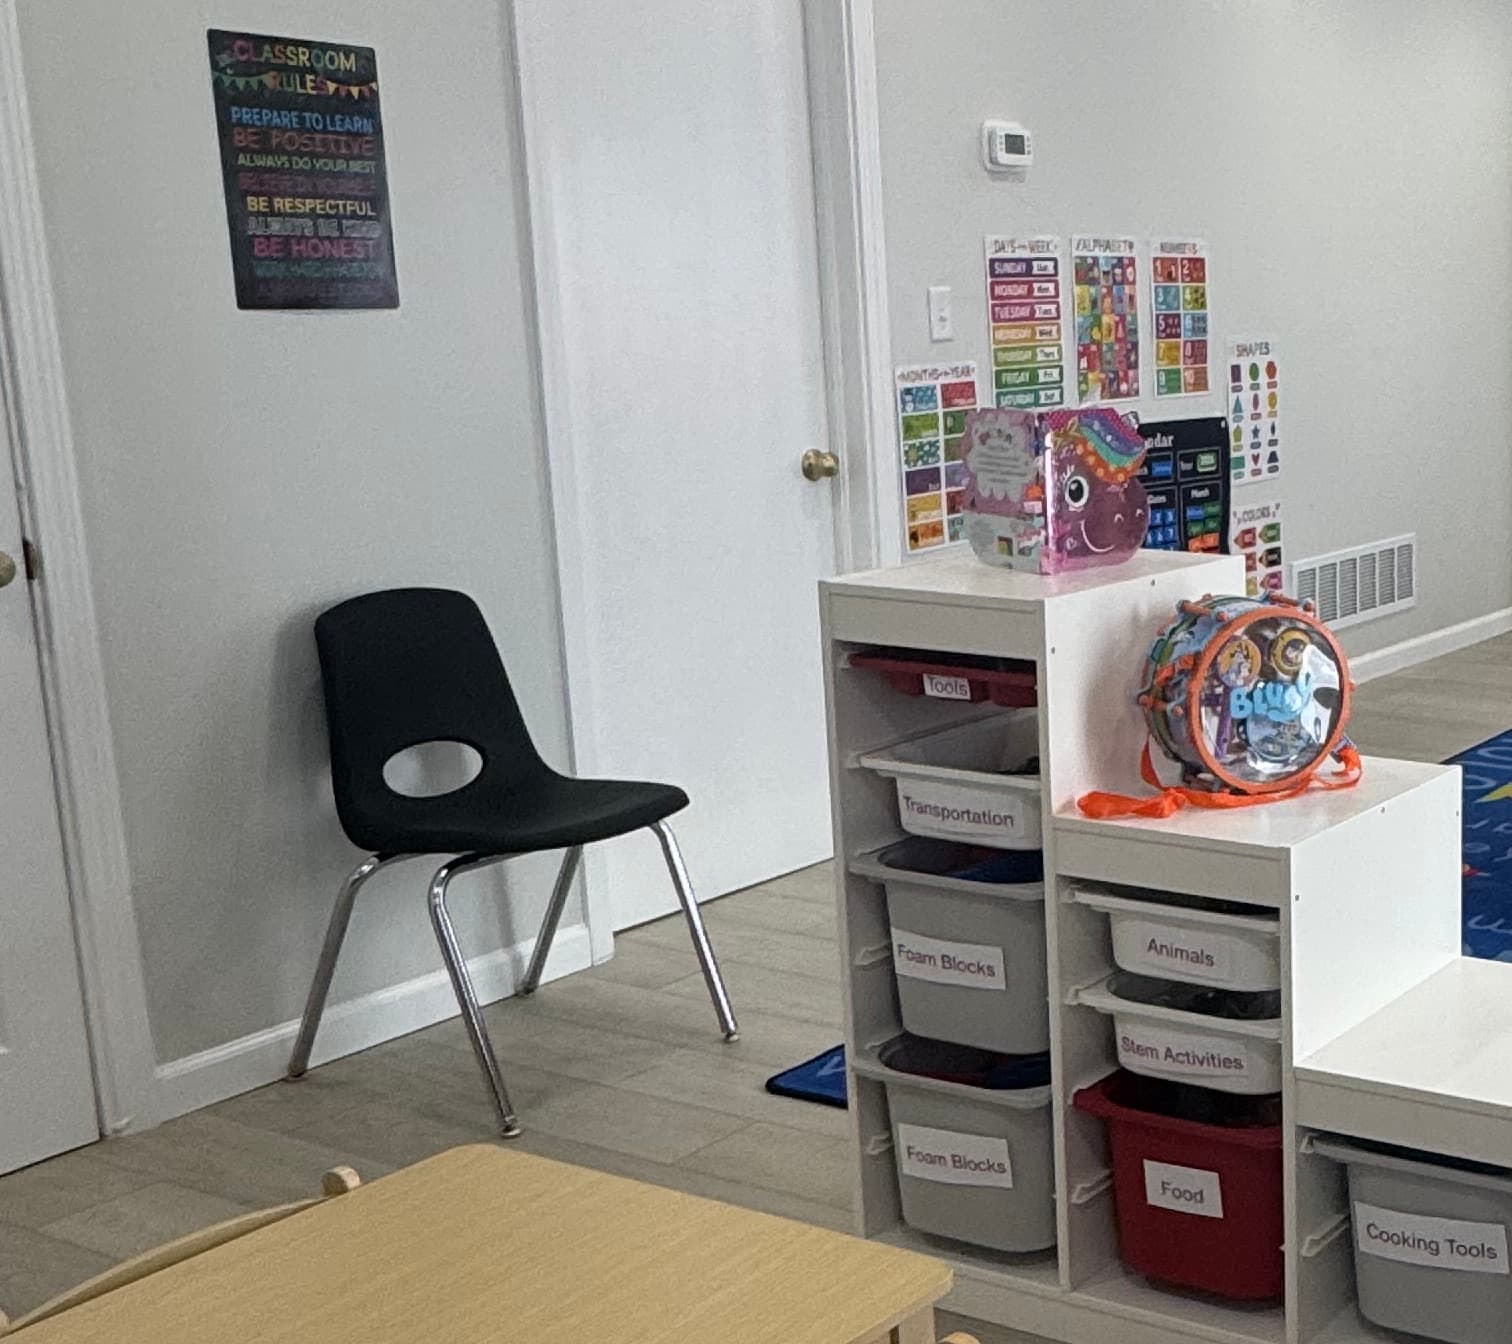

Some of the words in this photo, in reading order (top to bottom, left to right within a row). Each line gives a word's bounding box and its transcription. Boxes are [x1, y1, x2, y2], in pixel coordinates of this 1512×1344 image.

[232, 40, 356, 72] CLASSROOM
[230, 106, 300, 129] PREPARE
[303, 112, 321, 131] TO
[325, 115, 375, 134] LEARN
[231, 127, 258, 149] BE
[271, 130, 376, 155] POSITIVE
[236, 152, 290, 168] ALWAYS
[292, 155, 311, 170] DO
[313, 157, 350, 173] YOUR
[246, 195, 269, 213] BE
[272, 197, 377, 217] RESPECTFUL
[253, 236, 286, 258] BE
[289, 237, 377, 260] HONEST
[928, 675, 968, 697] Tools
[902, 794, 1015, 828] Transportation
[898, 943, 937, 968] Foam
[940, 953, 996, 978] Blocks
[1146, 937, 1215, 968] Animals
[1121, 1035, 1160, 1061] Stem
[1163, 1045, 1244, 1071] Activities
[906, 1145, 948, 1168] Foam
[950, 1153, 1007, 1175] Blocks
[1159, 1179, 1205, 1205] Food
[1365, 1221, 1441, 1257] Cooking
[1445, 1237, 1498, 1260] Tools
